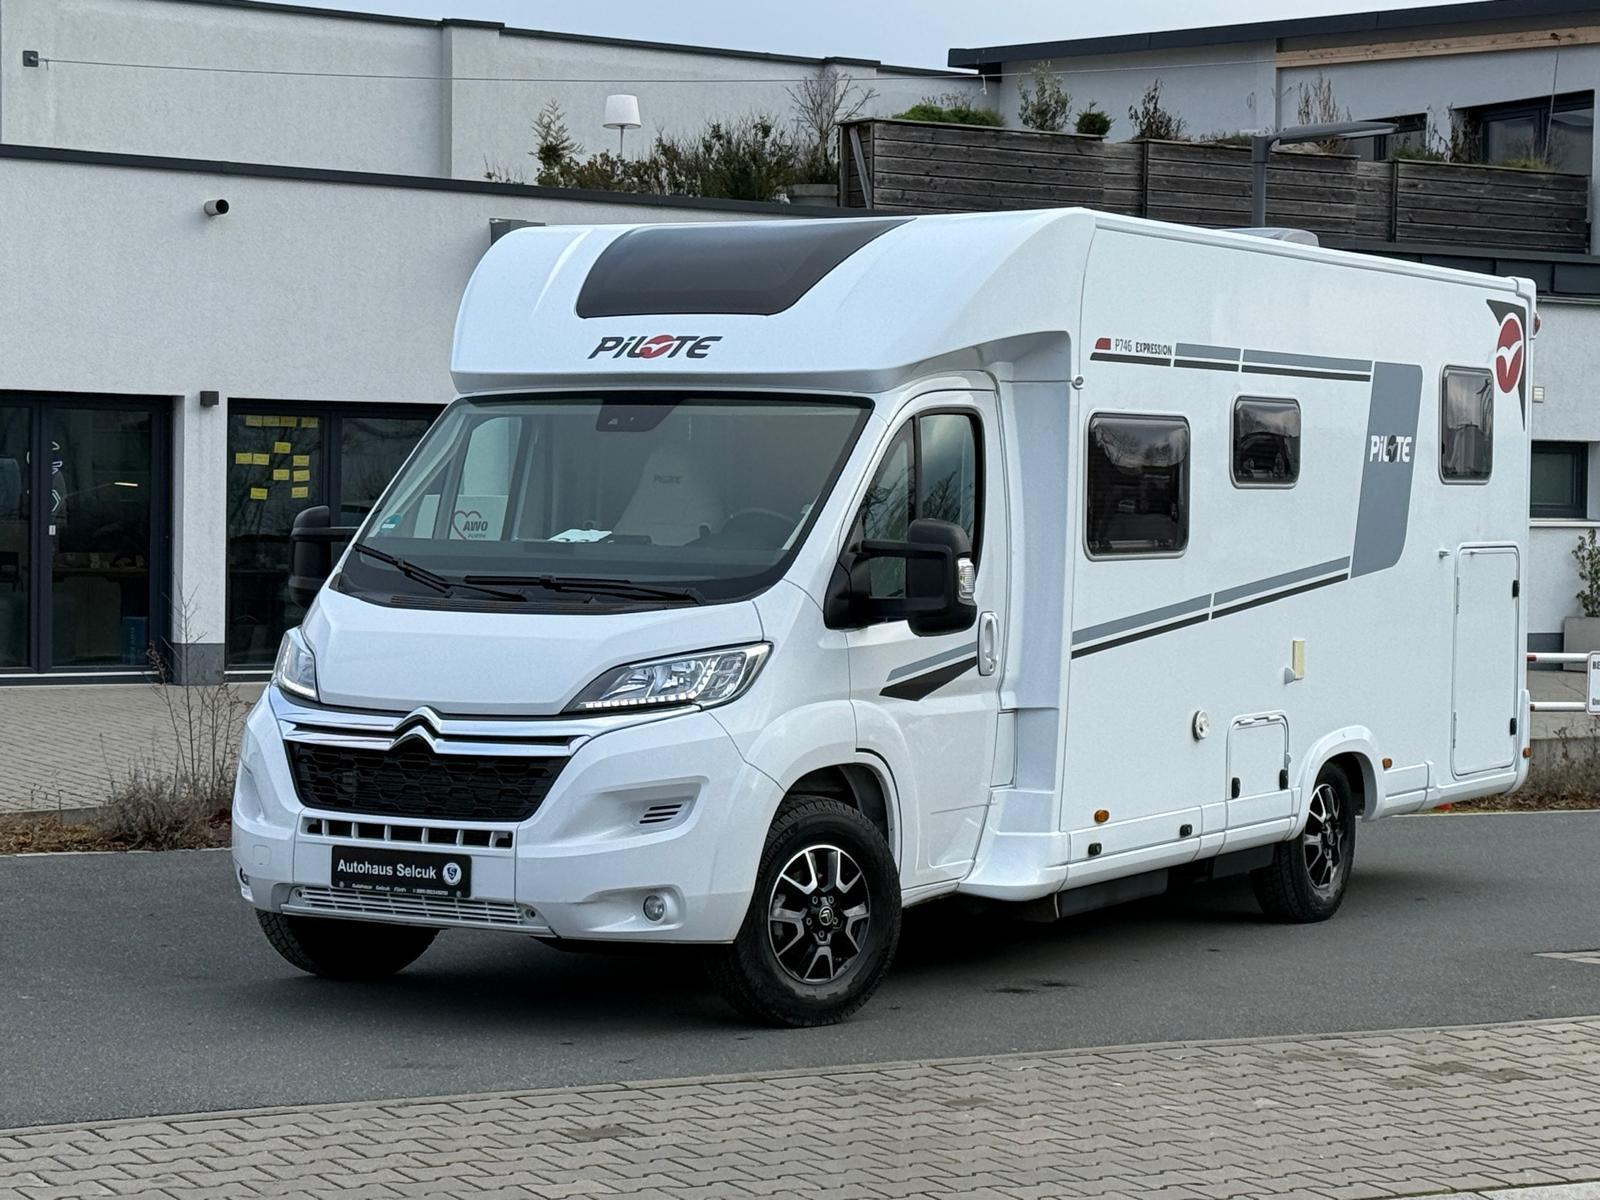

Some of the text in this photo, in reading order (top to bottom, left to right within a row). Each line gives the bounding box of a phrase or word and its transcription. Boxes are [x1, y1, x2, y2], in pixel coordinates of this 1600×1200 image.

[1115, 338, 1172, 356] P746 EXPRESSION
[463, 520, 488, 531] AWO
[337, 859, 437, 879] Autohaus Selcuk
